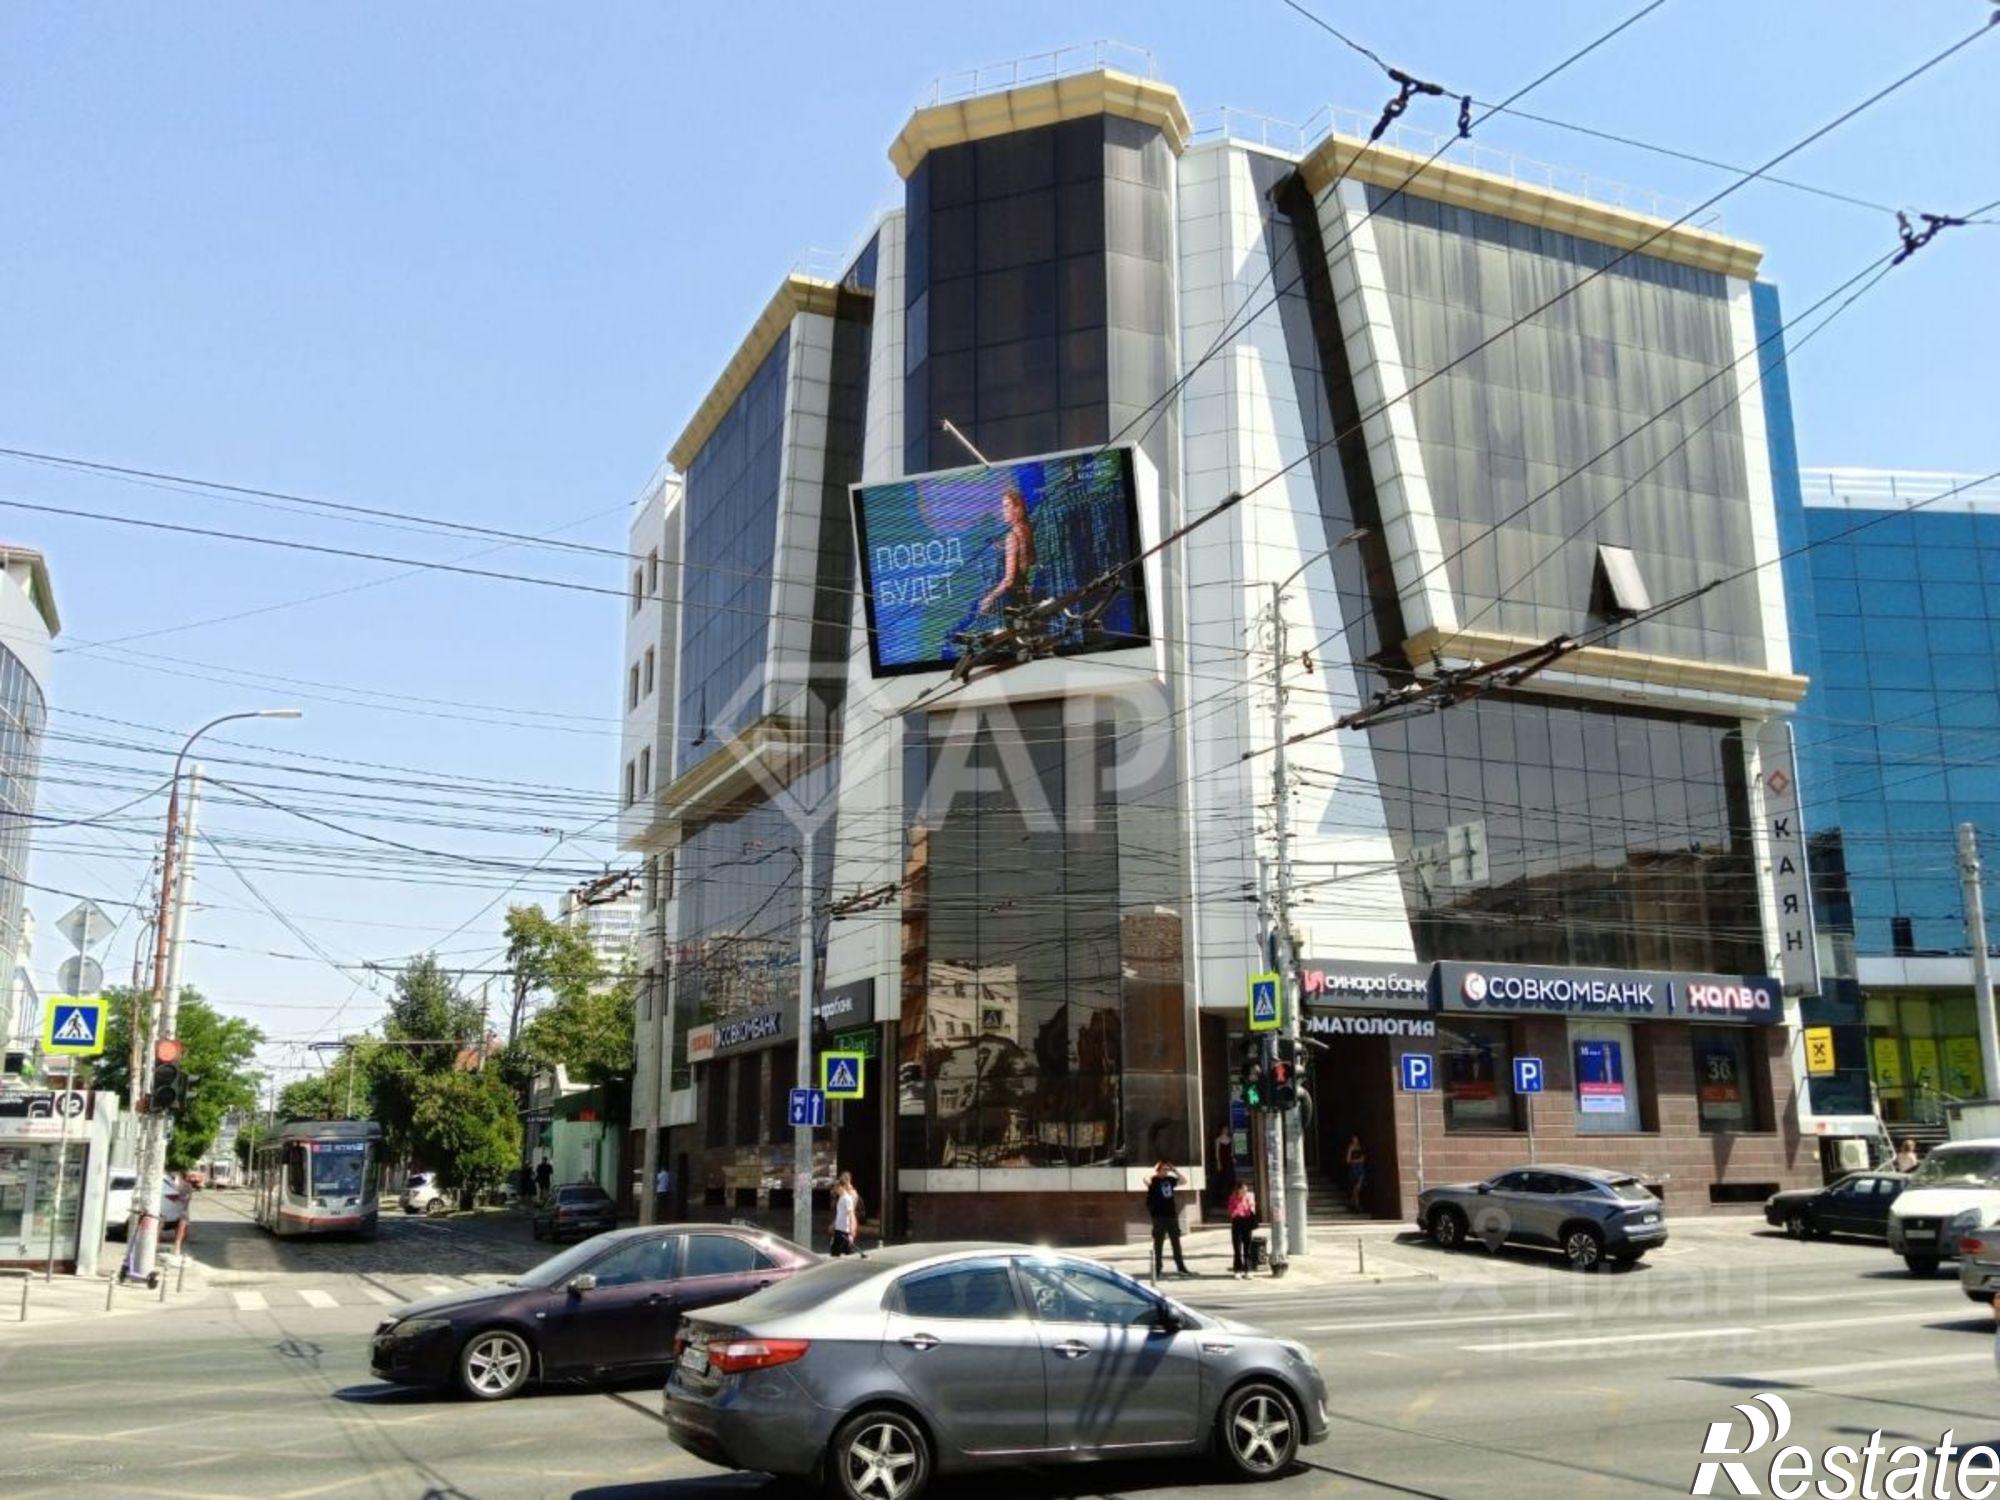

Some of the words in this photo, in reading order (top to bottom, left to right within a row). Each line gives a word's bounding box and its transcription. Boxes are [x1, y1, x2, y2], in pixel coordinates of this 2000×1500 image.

[876, 537, 963, 573] ПОВОД
[879, 573, 954, 606] БУДЕТ
[1773, 817, 1803, 951] КАЯН
[1325, 974, 1386, 991] синара
[1388, 973, 1427, 993] банк
[1489, 977, 1654, 1005] СОВКОМБАНК
